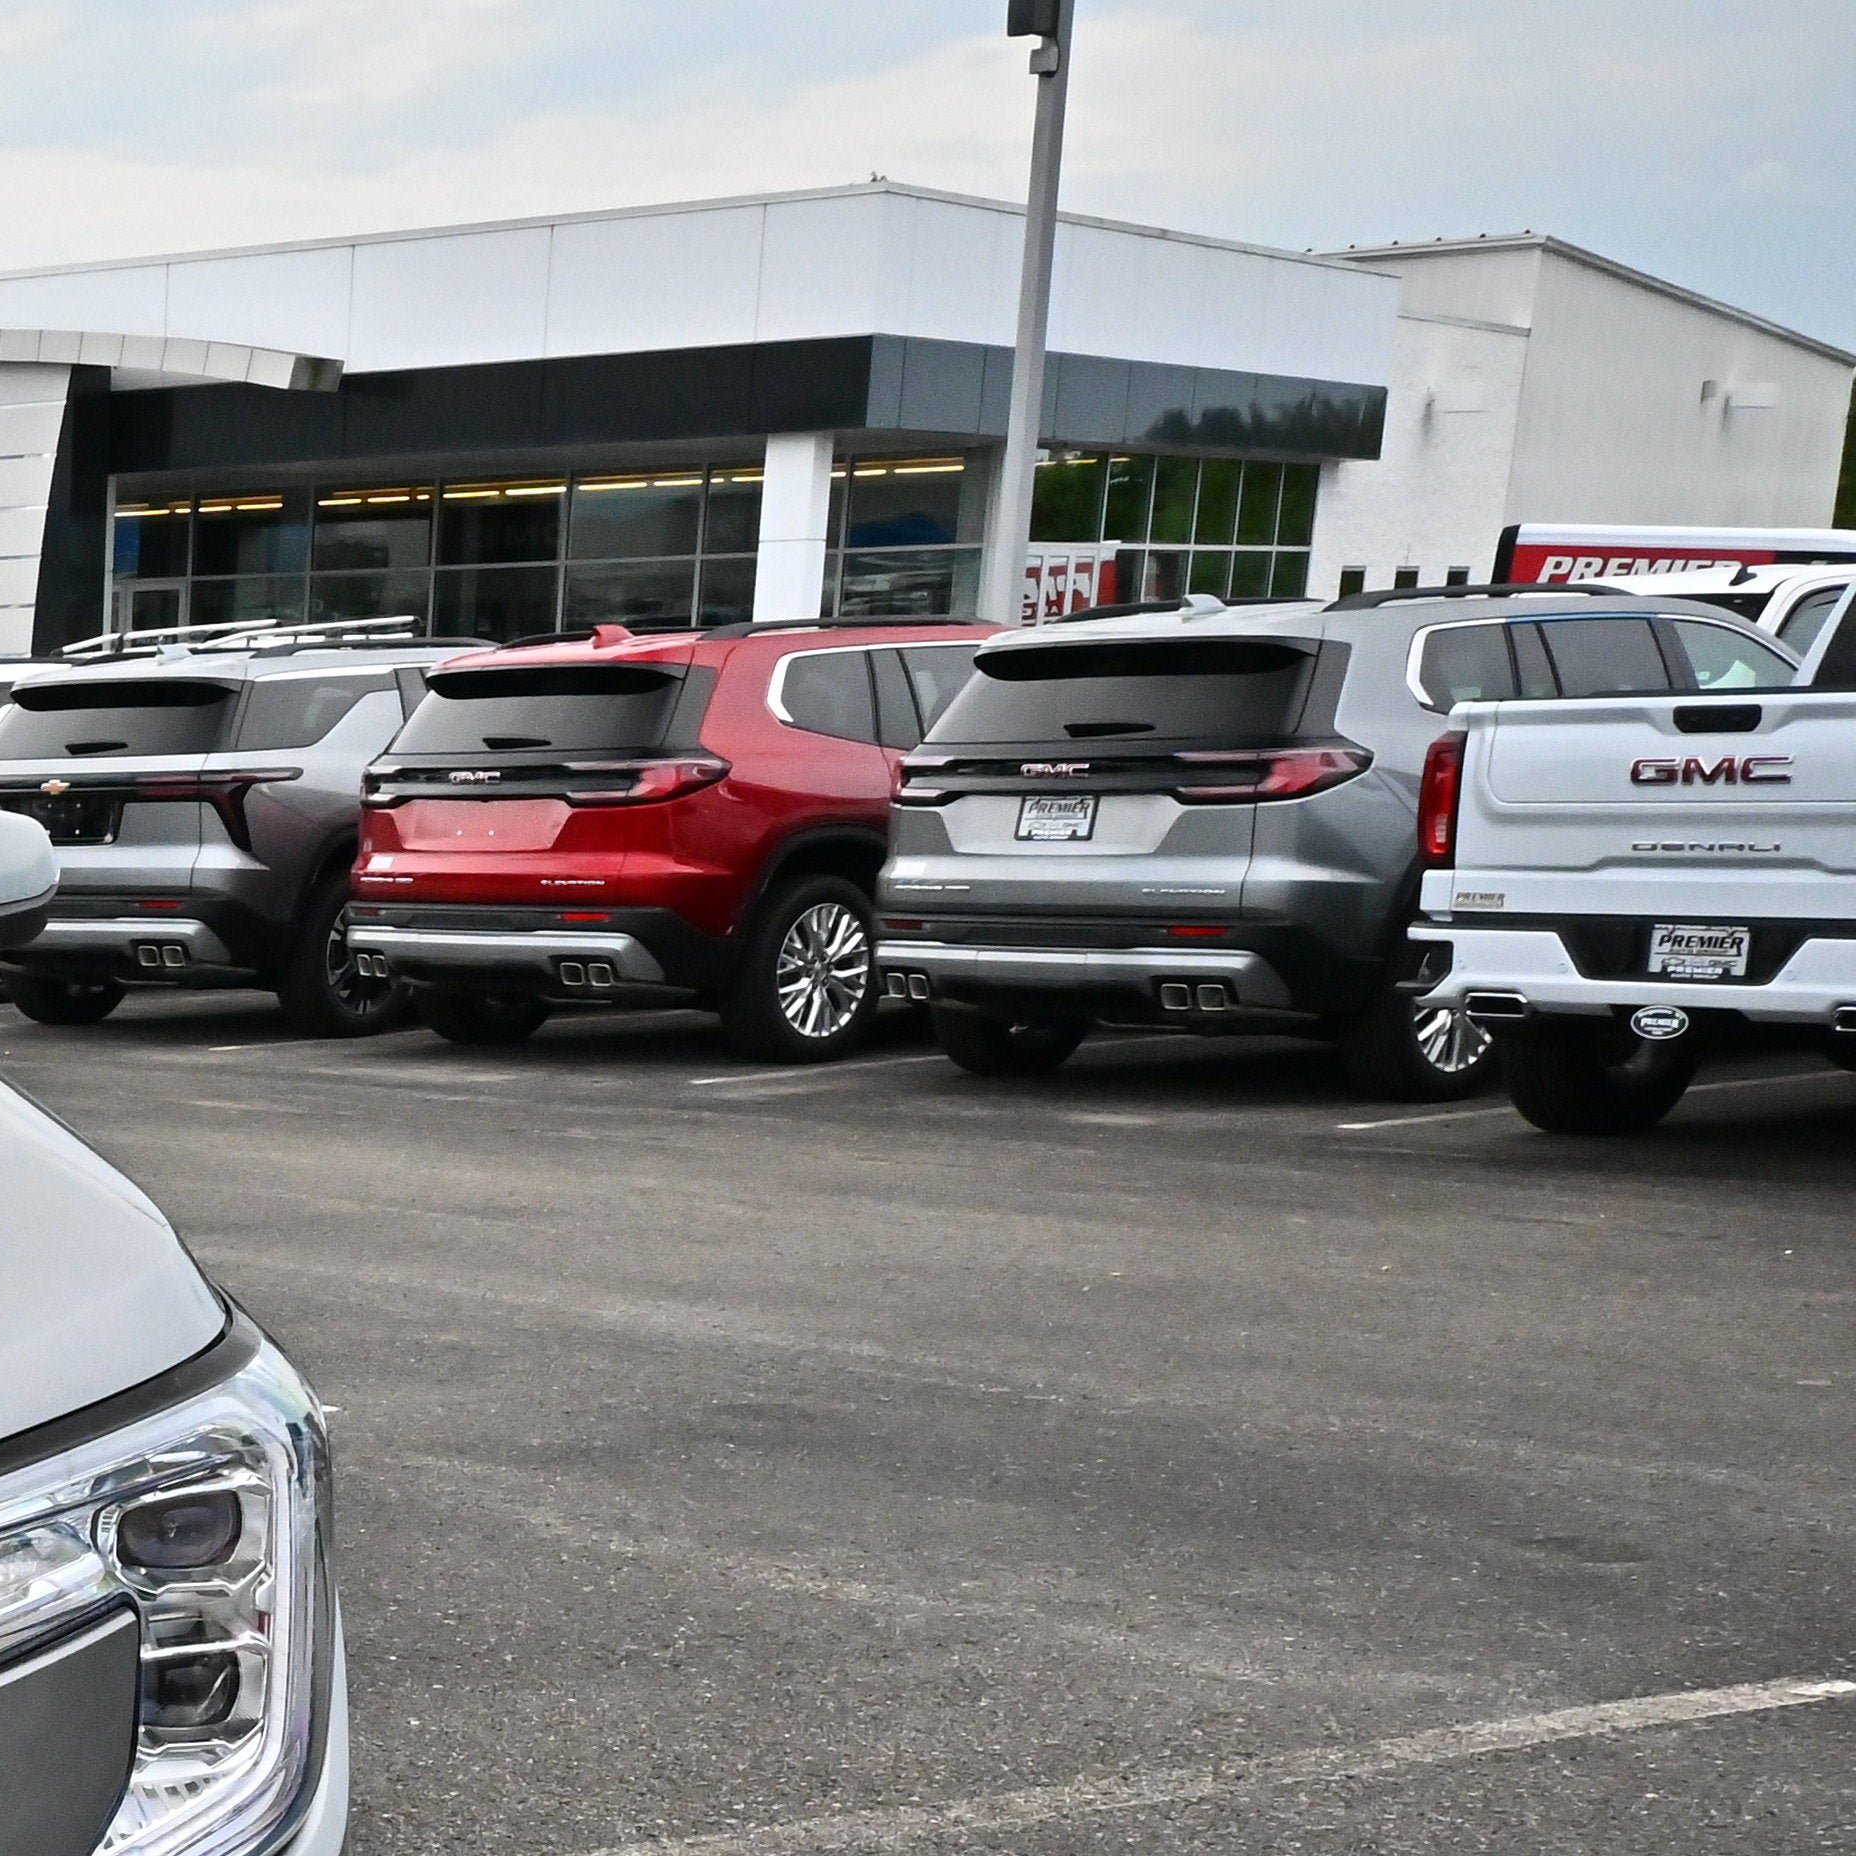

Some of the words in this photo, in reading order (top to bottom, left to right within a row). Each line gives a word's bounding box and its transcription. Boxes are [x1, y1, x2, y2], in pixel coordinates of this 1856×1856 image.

[1020, 763, 1091, 778] GMC
[1630, 755, 1794, 786] GMC
[1631, 842, 1781, 851] DENALI
[1658, 934, 1744, 957] PREMIER
